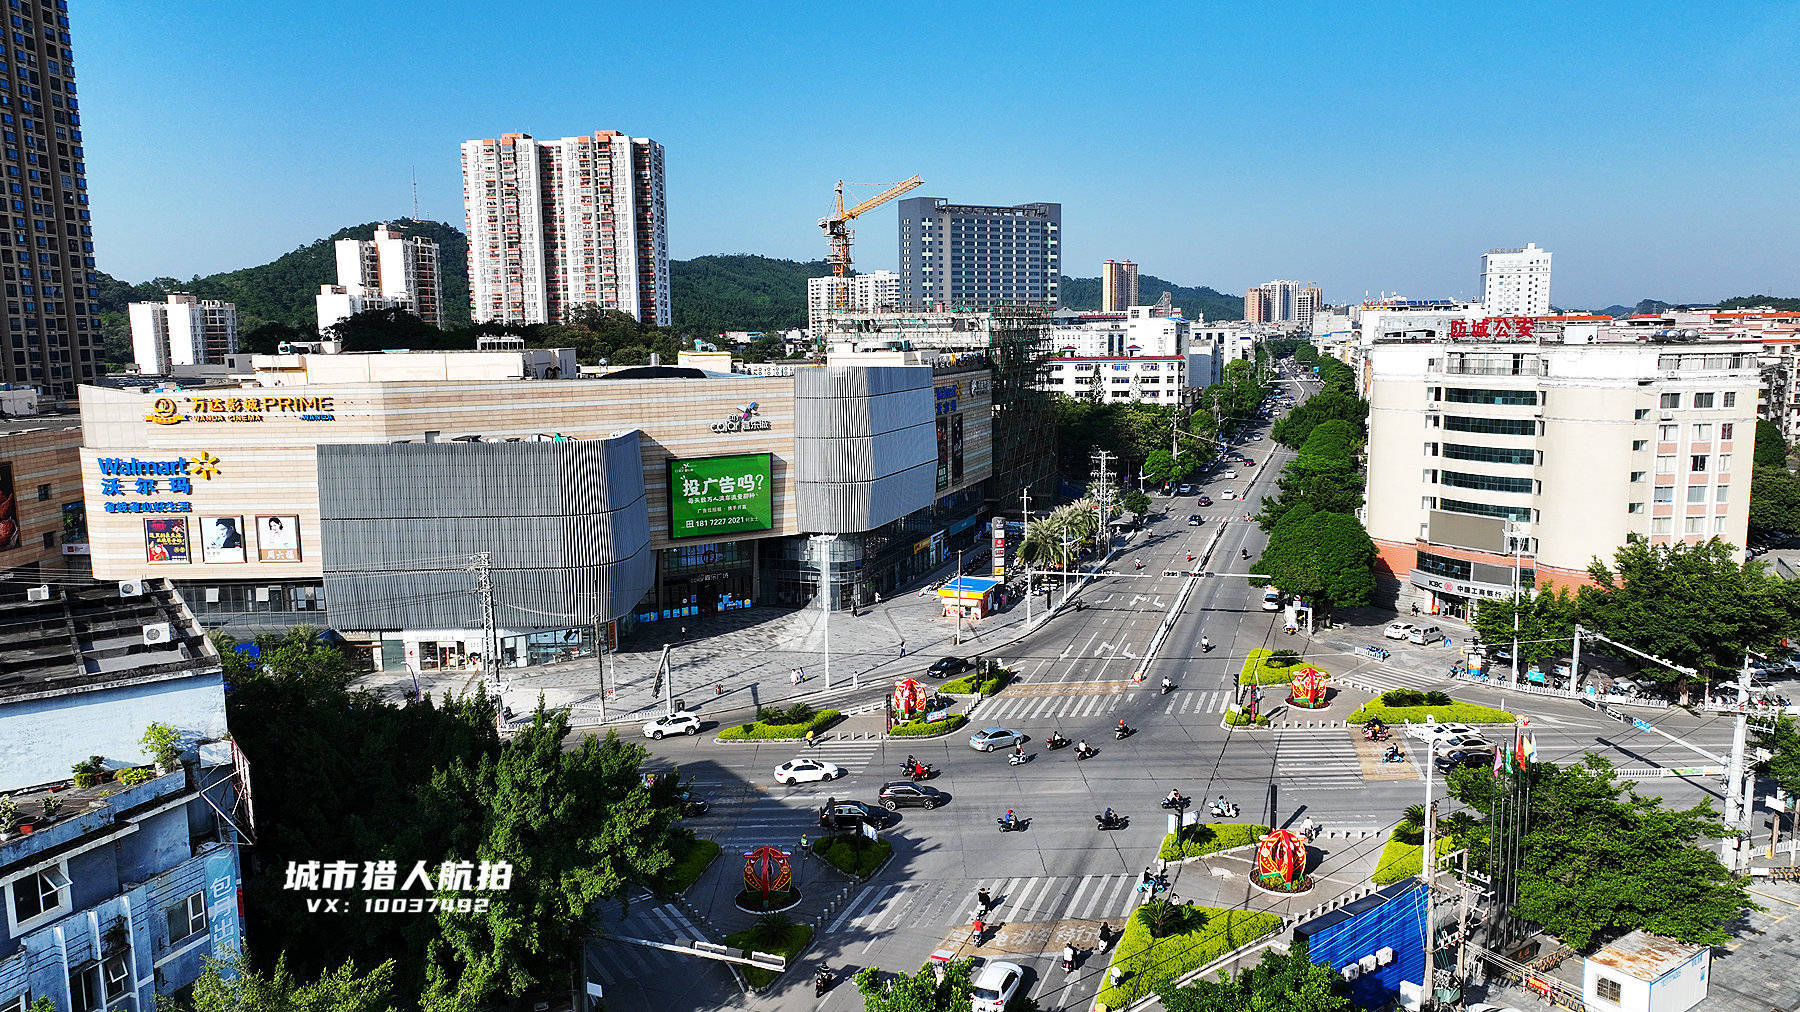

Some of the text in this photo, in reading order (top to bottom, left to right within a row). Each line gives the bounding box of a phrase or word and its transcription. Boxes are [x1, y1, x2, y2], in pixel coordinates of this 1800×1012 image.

[1450, 317, 1535, 338] 防城公安
[192, 397, 334, 412] 万达影城 PRIME
[97, 457, 190, 475] Walmart
[101, 477, 190, 494] 沃尔玛
[682, 474, 764, 497] 投广告吗?
[728, 516, 744, 524] 2021
